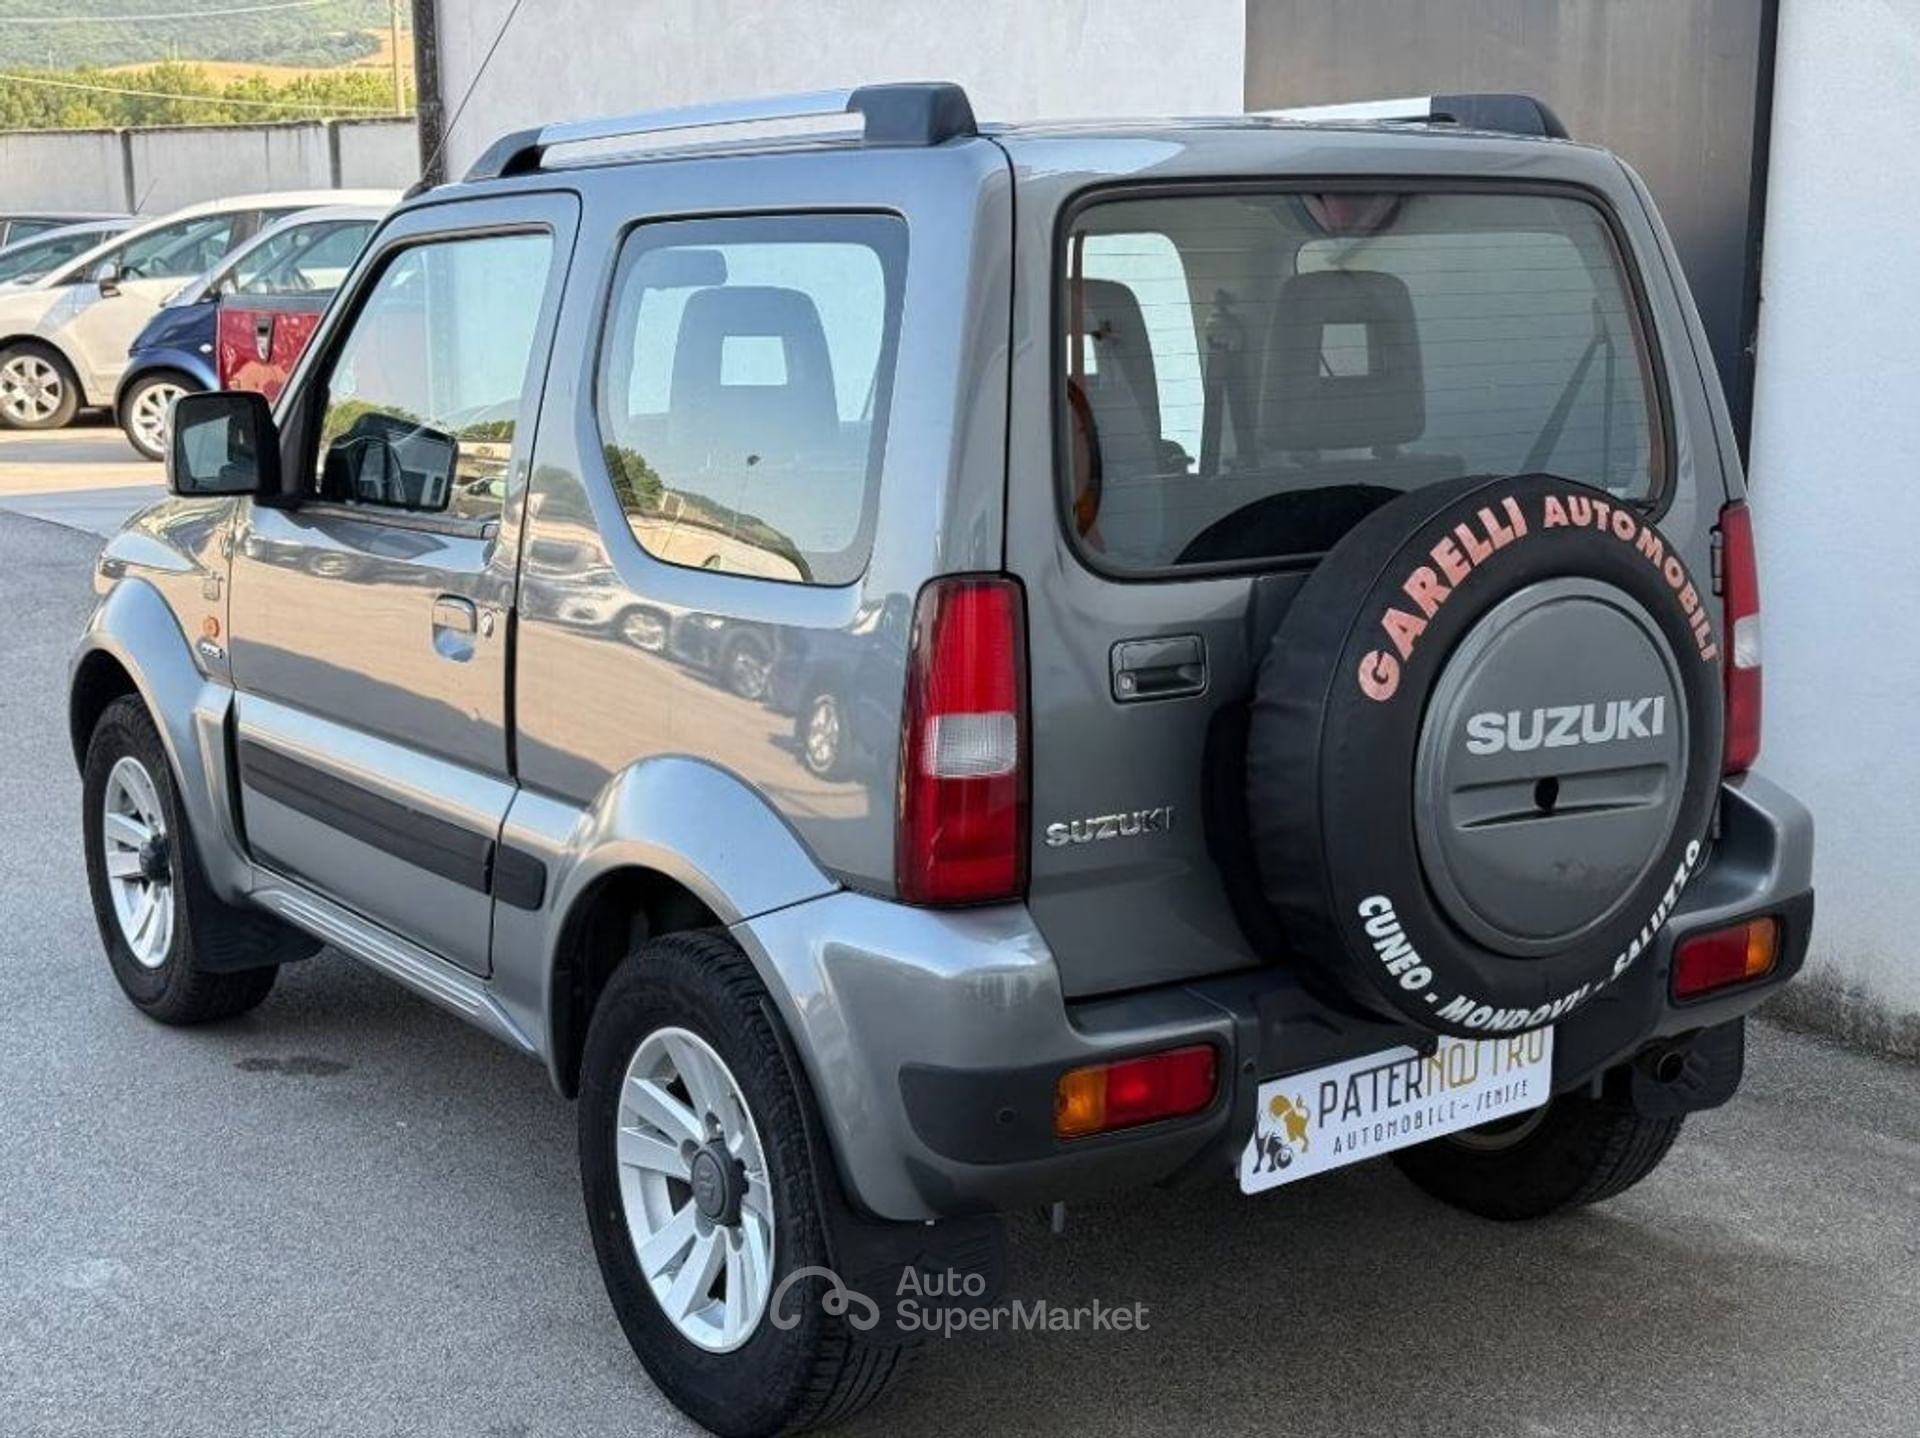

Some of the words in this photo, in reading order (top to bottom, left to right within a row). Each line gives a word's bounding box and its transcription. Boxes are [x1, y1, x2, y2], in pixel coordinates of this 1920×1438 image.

[1358, 496, 1528, 701] GARELLI
[1543, 495, 1717, 662] AUTOMOBILI
[1466, 696, 1665, 755] SUZUKI
[1045, 805, 1174, 847] SUZUKI
[1358, 895, 1433, 990] CUNEO
[1610, 839, 1701, 982] SALUZZO
